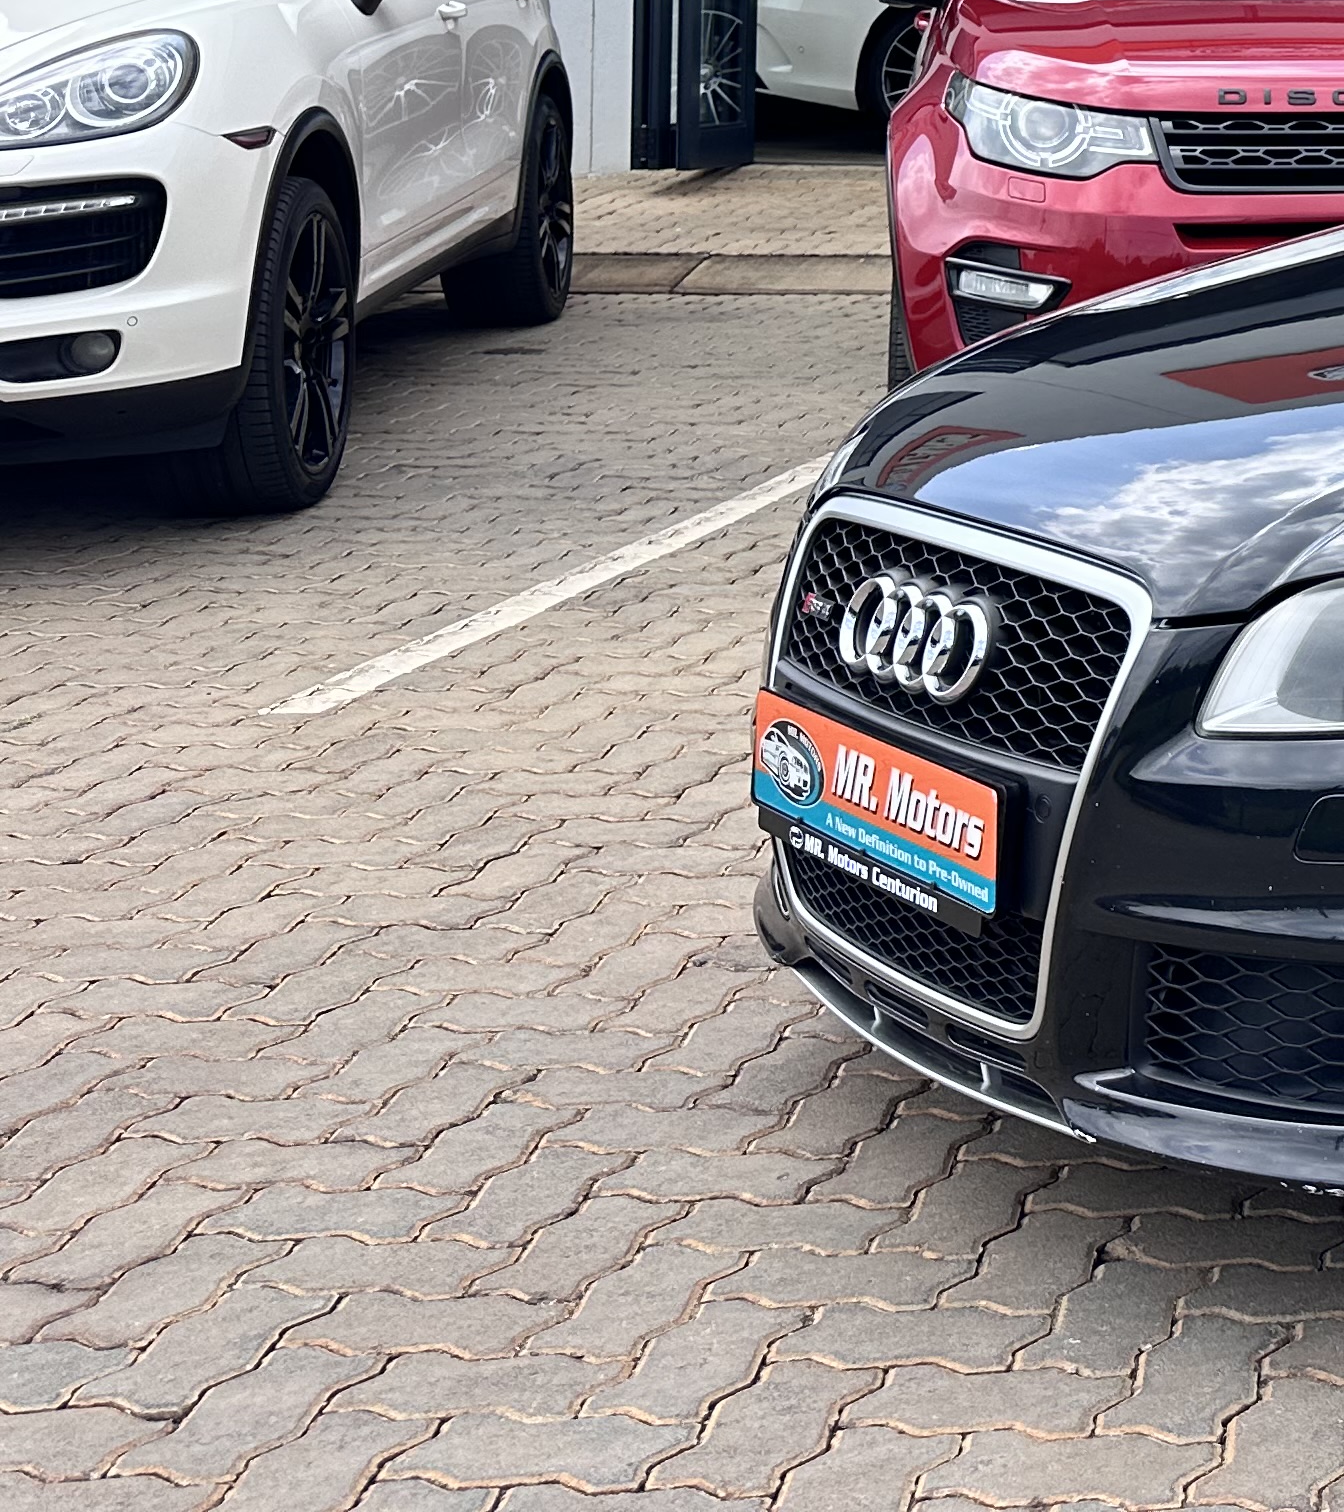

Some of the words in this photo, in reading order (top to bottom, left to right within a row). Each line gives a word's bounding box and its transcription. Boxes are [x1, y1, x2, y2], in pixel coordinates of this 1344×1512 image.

[831, 744, 878, 813] MR.
[884, 767, 985, 858] Motors
[804, 834, 824, 859] MR.
[828, 845, 868, 880] Motors
[872, 869, 938, 913] Centurion
[826, 813, 833, 826] A
[835, 817, 856, 838] New
[858, 828, 911, 865] Definition
[914, 854, 927, 872] to
[928, 859, 989, 903] Pre-Owned
